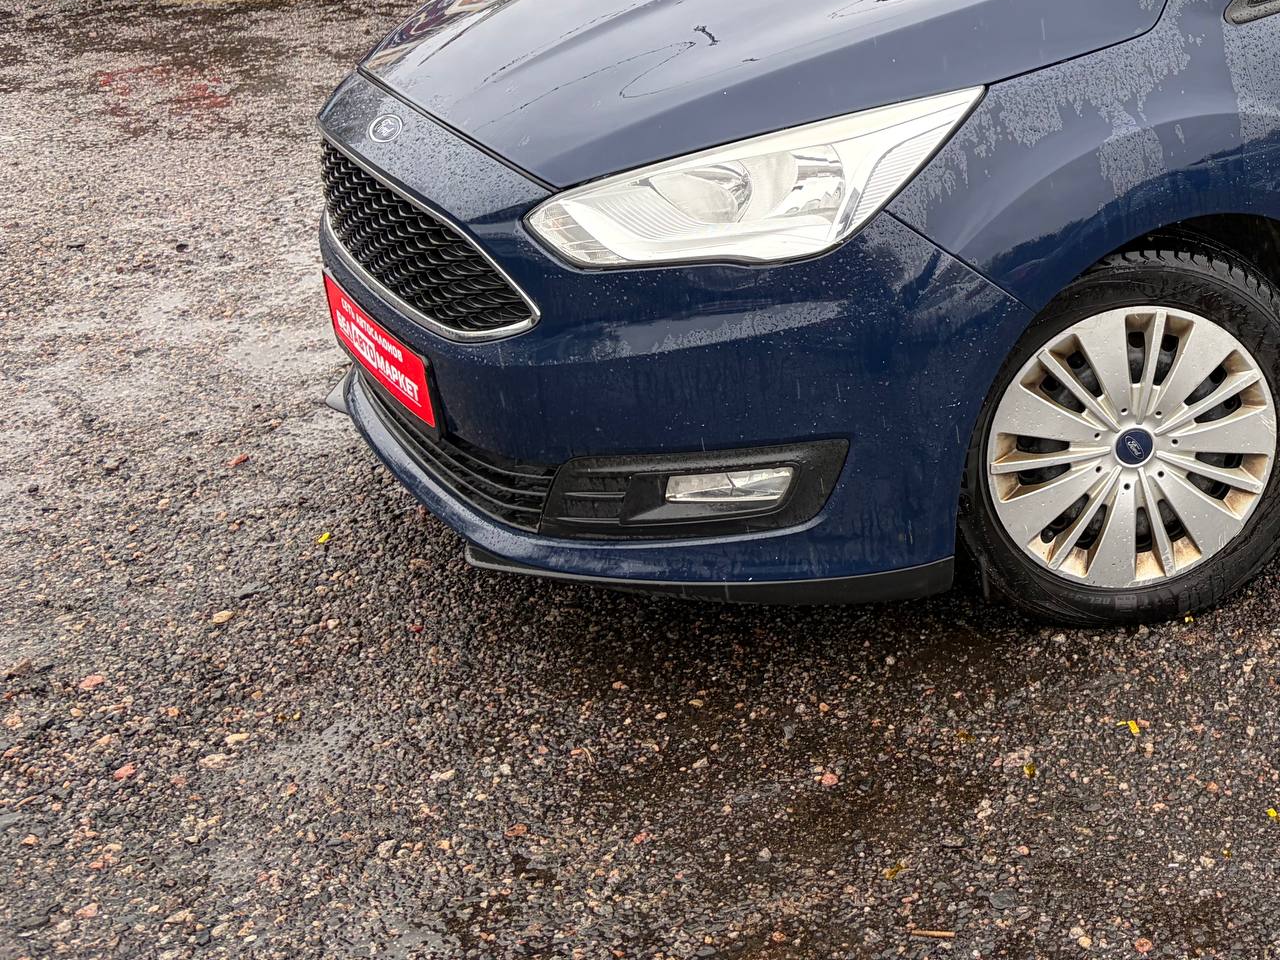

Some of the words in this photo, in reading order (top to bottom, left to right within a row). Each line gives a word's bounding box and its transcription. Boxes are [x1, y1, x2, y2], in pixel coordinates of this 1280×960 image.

[336, 309, 353, 340] БЕЛ
[375, 352, 419, 401] МАРКЕТ
[356, 313, 403, 363] АВТОСАЛОНОВ
